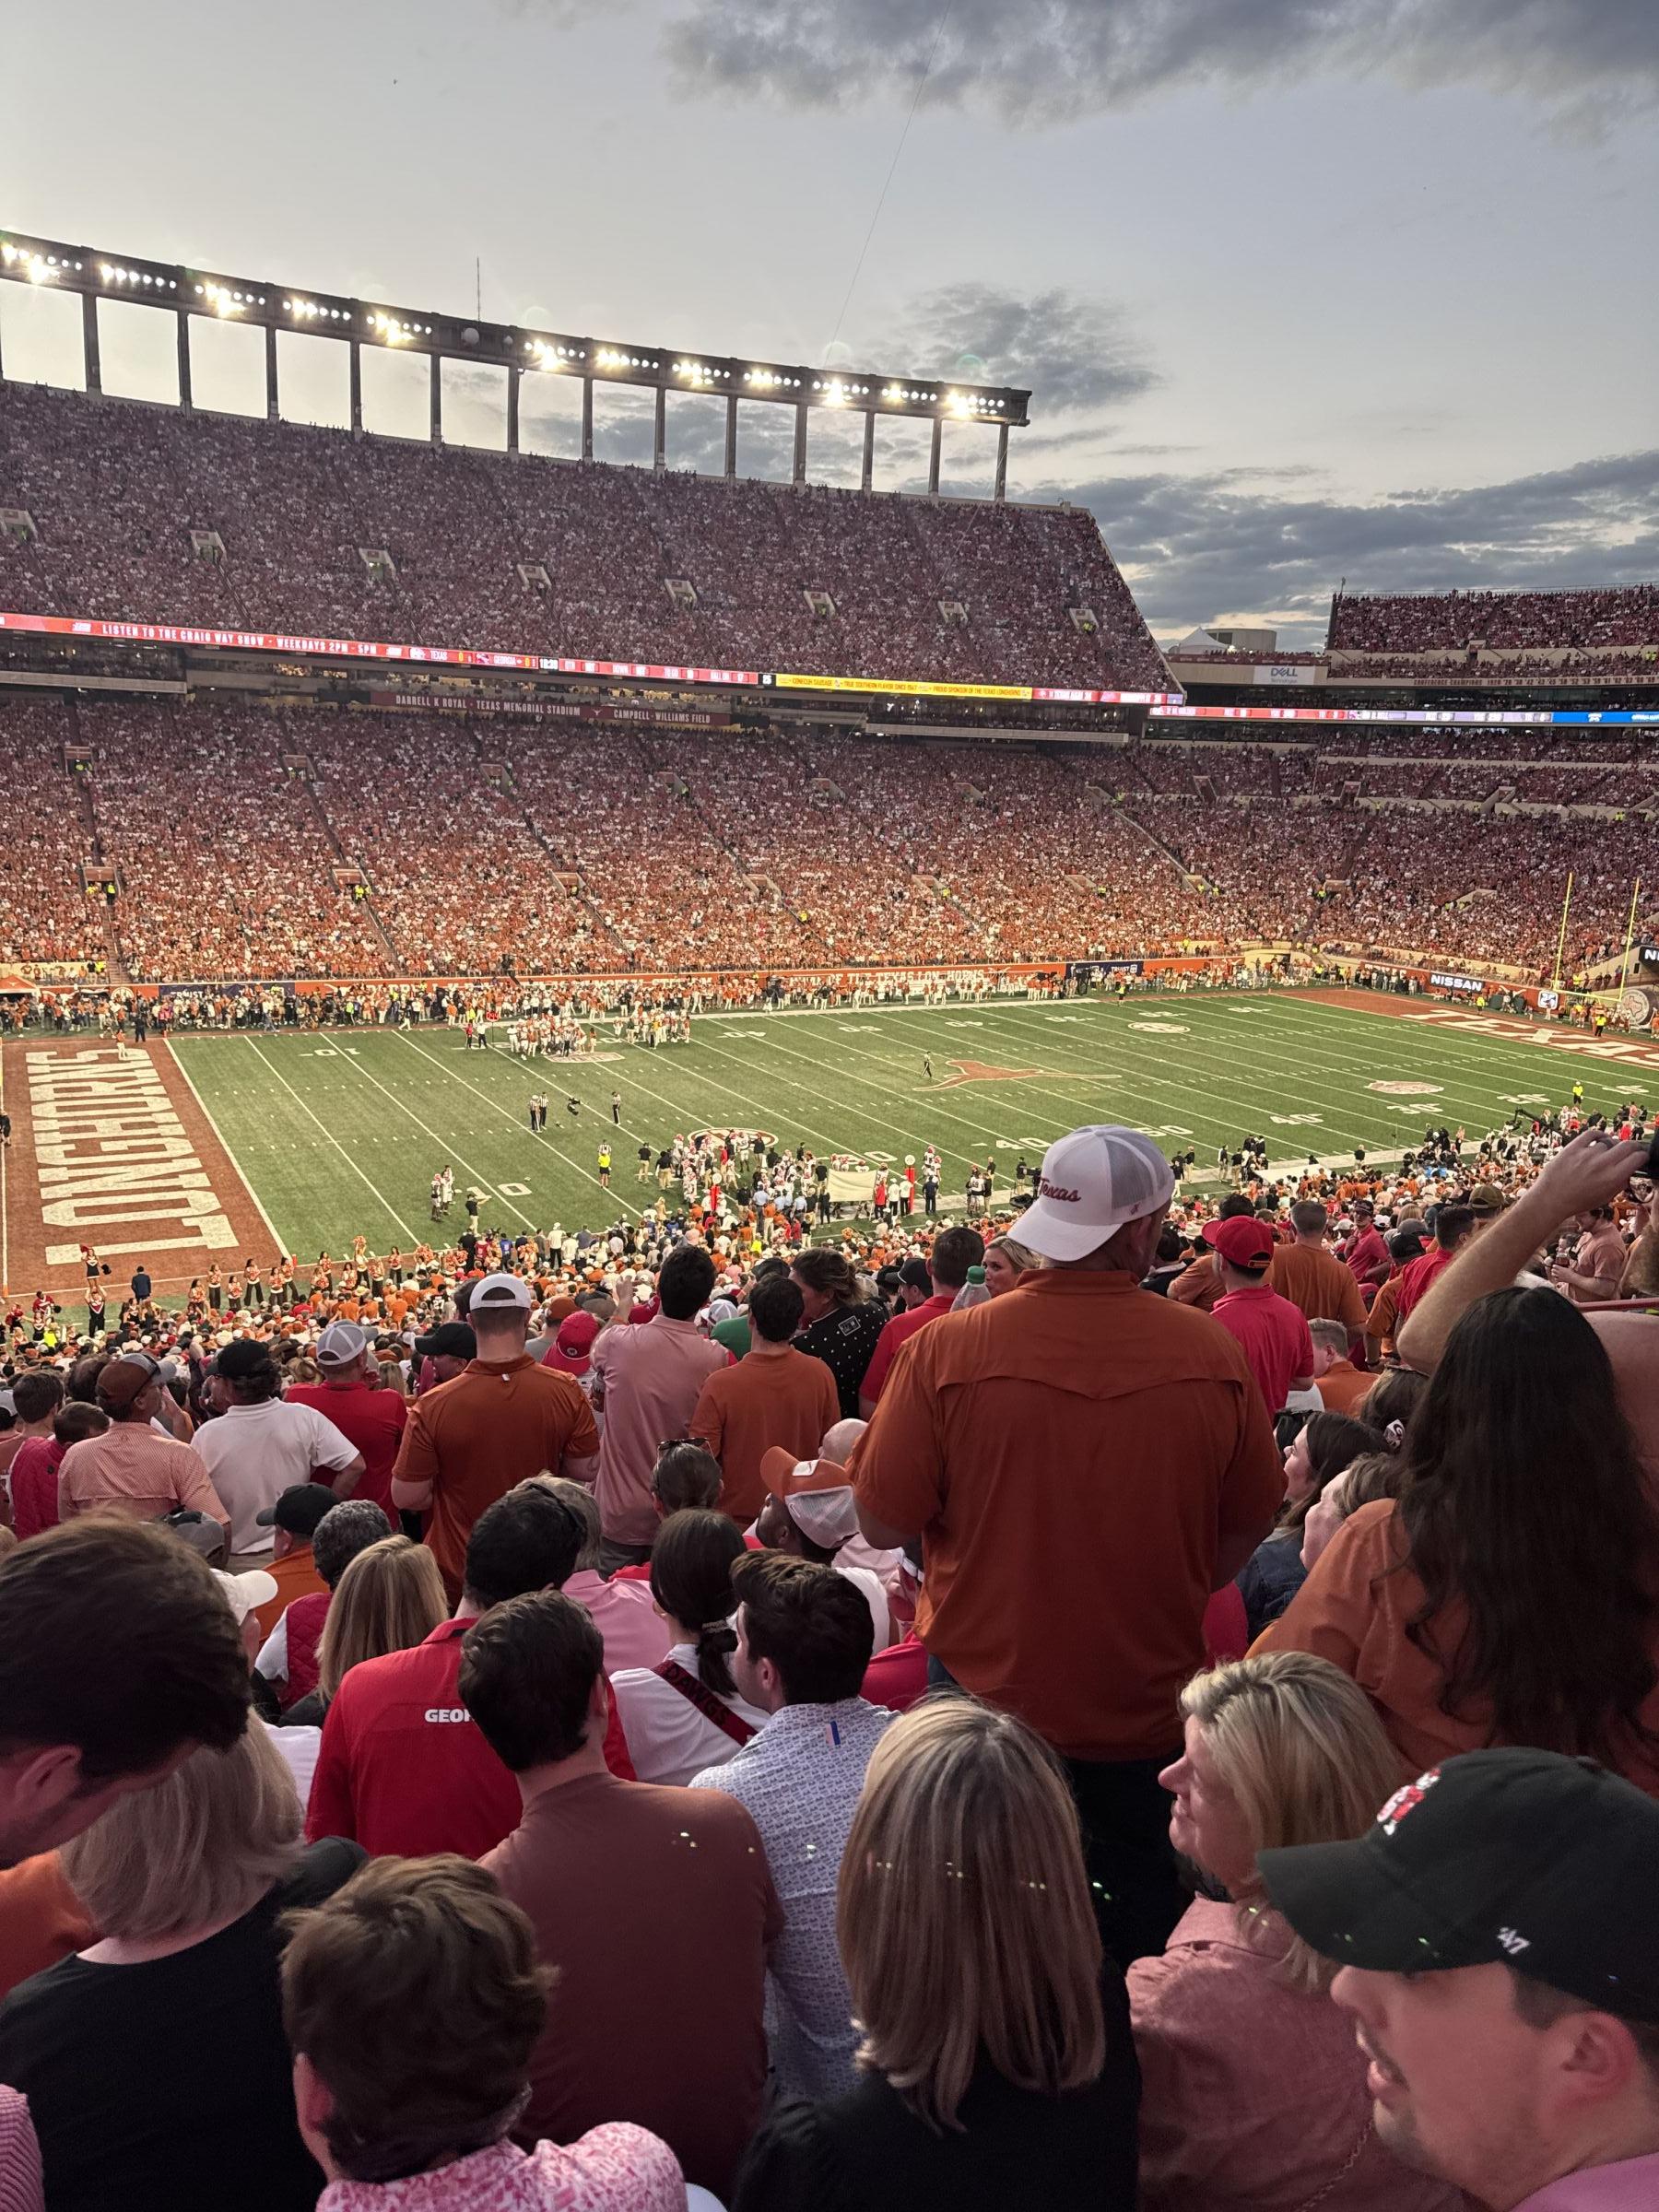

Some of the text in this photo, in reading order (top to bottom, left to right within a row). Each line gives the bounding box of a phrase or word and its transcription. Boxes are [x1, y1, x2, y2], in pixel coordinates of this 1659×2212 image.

[102, 624, 138, 636] LISTEN
[143, 628, 155, 638] TO
[159, 629, 177, 640] THE
[180, 630, 211, 642] CRAIG
[215, 632, 233, 643] WAY
[237, 635, 265, 646] SHOW
[276, 638, 325, 651] WEEKDAYS
[329, 643, 348, 653] 2PM
[358, 644, 377, 654] 5PM
[430, 650, 448, 661] TEXAS
[494, 654, 516, 665] GEORGIA
[395, 695, 430, 707] DARRELL
[434, 697, 440, 706] K
[442, 698, 467, 709] ROYAL
[477, 700, 500, 711] TEXAS
[503, 702, 544, 713] MEMORIAL
[547, 705, 581, 716] STADIUM
[691, 713, 711, 724] FIELD
[1430, 974, 1482, 992] NISSAN
[1270, 1113, 1324, 1125] 40
[1131, 1124, 1194, 1136] 50
[995, 1137, 1053, 1149] 40
[26, 1048, 240, 1265] LONGHORNS
[467, 1182, 532, 1199] 10
[1040, 1178, 1081, 1202] Texas
